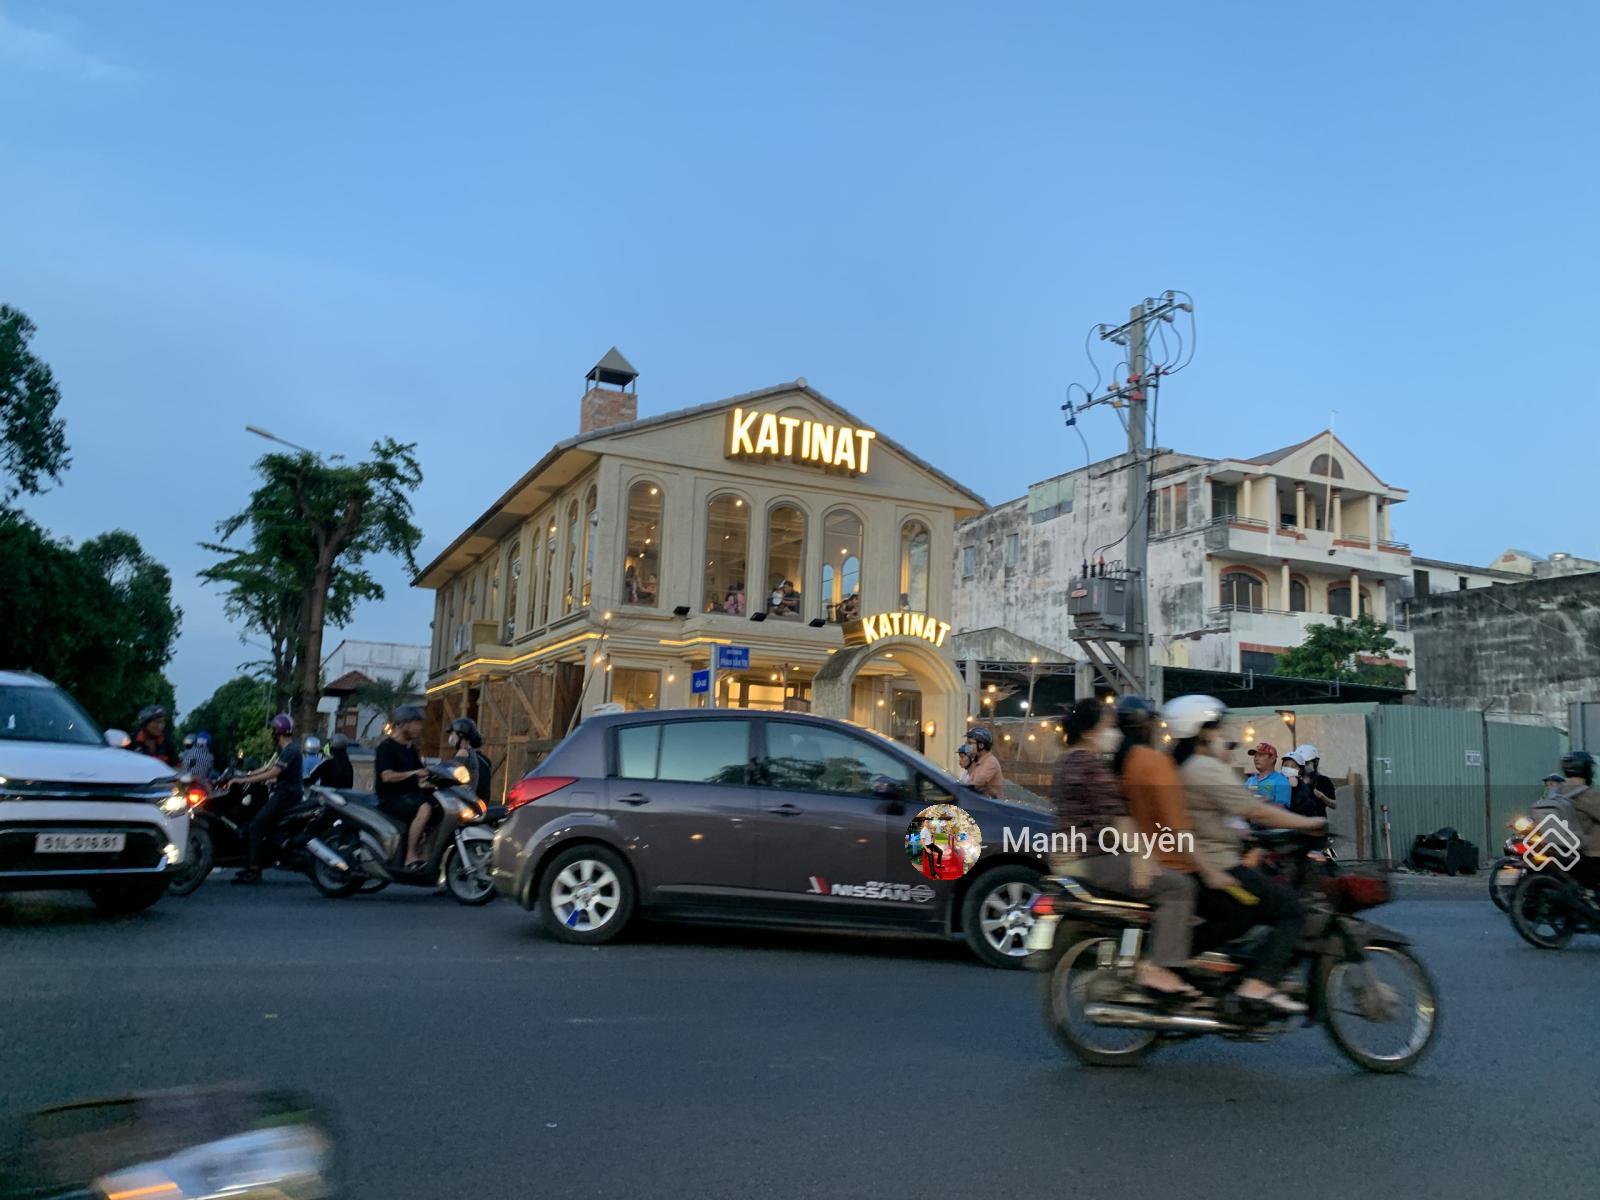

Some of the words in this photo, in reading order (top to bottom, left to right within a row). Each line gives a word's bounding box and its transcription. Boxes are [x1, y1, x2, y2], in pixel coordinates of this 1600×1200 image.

[731, 407, 876, 474] KATINAT
[862, 612, 951, 648] KATINAT
[831, 883, 911, 901] NISSAN
